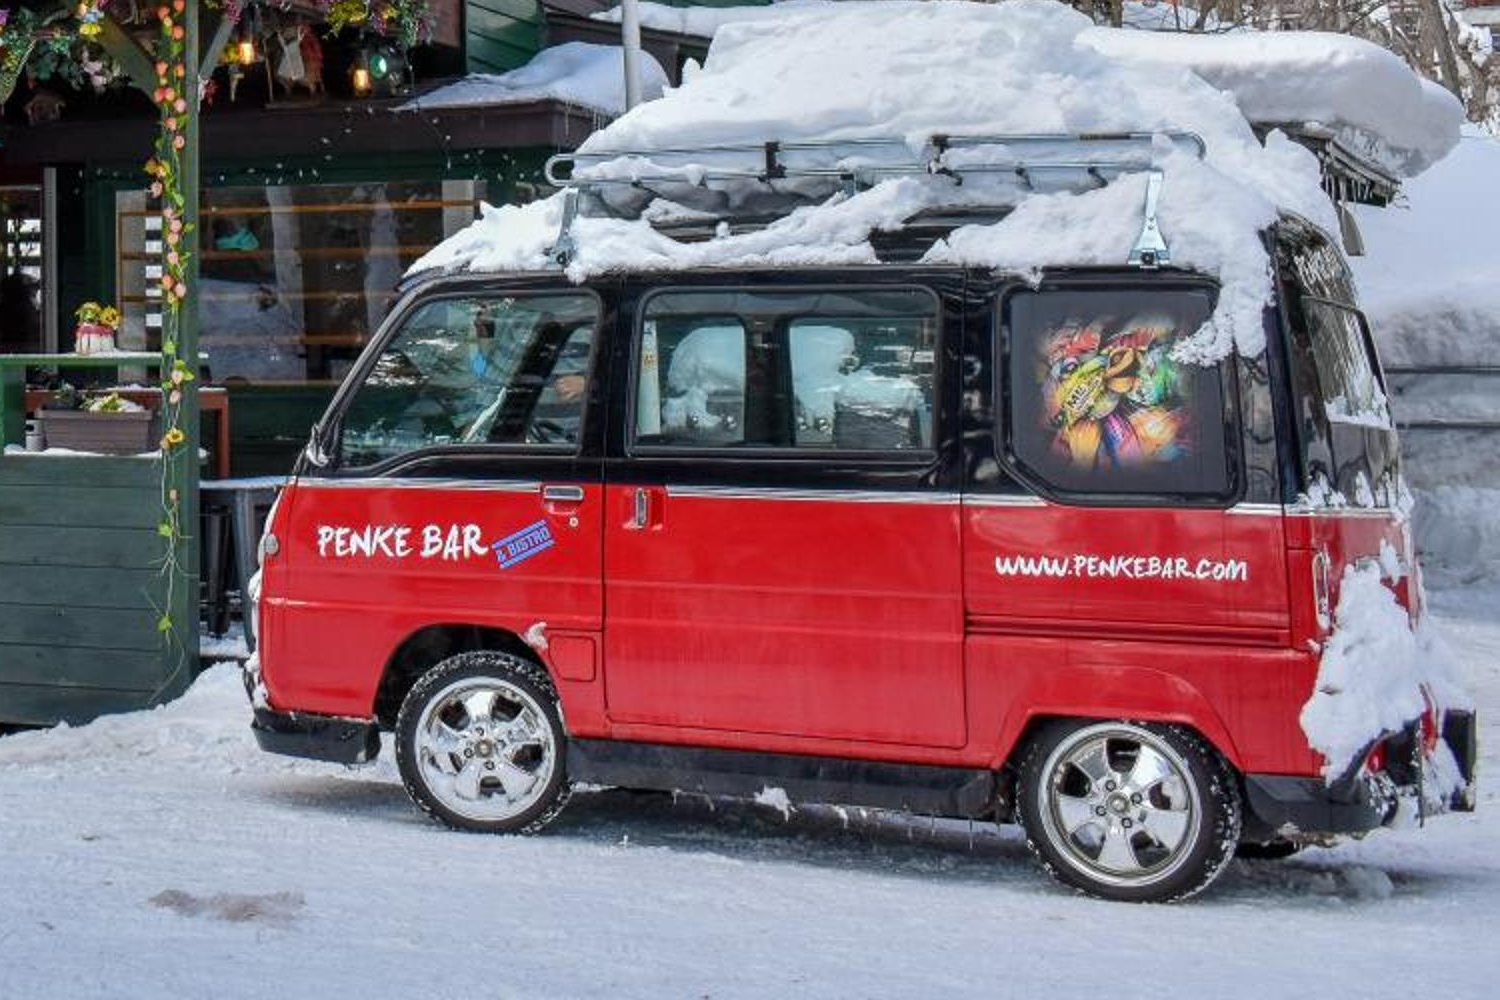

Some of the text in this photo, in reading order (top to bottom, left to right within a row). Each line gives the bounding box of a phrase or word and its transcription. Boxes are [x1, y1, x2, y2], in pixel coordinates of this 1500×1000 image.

[317, 522, 489, 561] PENKE BAR
[508, 527, 550, 556] BISTRO
